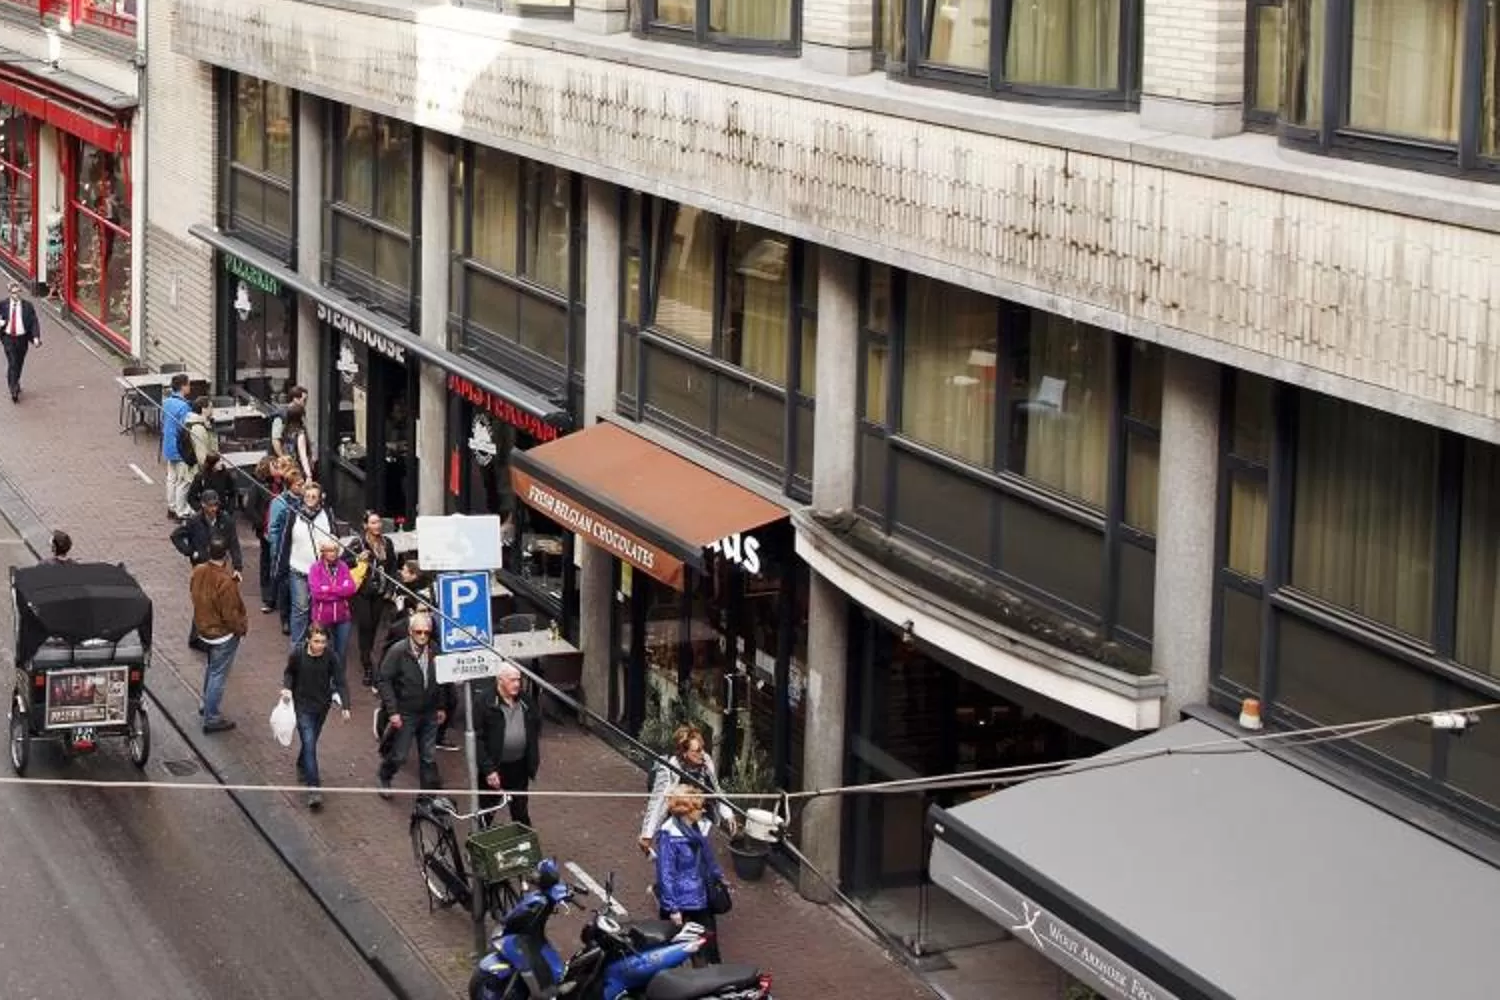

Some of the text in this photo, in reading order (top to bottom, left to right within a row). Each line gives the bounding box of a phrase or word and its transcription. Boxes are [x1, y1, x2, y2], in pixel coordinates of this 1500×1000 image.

[317, 302, 405, 363] STEAKHOUSE
[528, 485, 655, 569] FRESH BELGIAN CHOCOLATES
[451, 579, 479, 619] P
